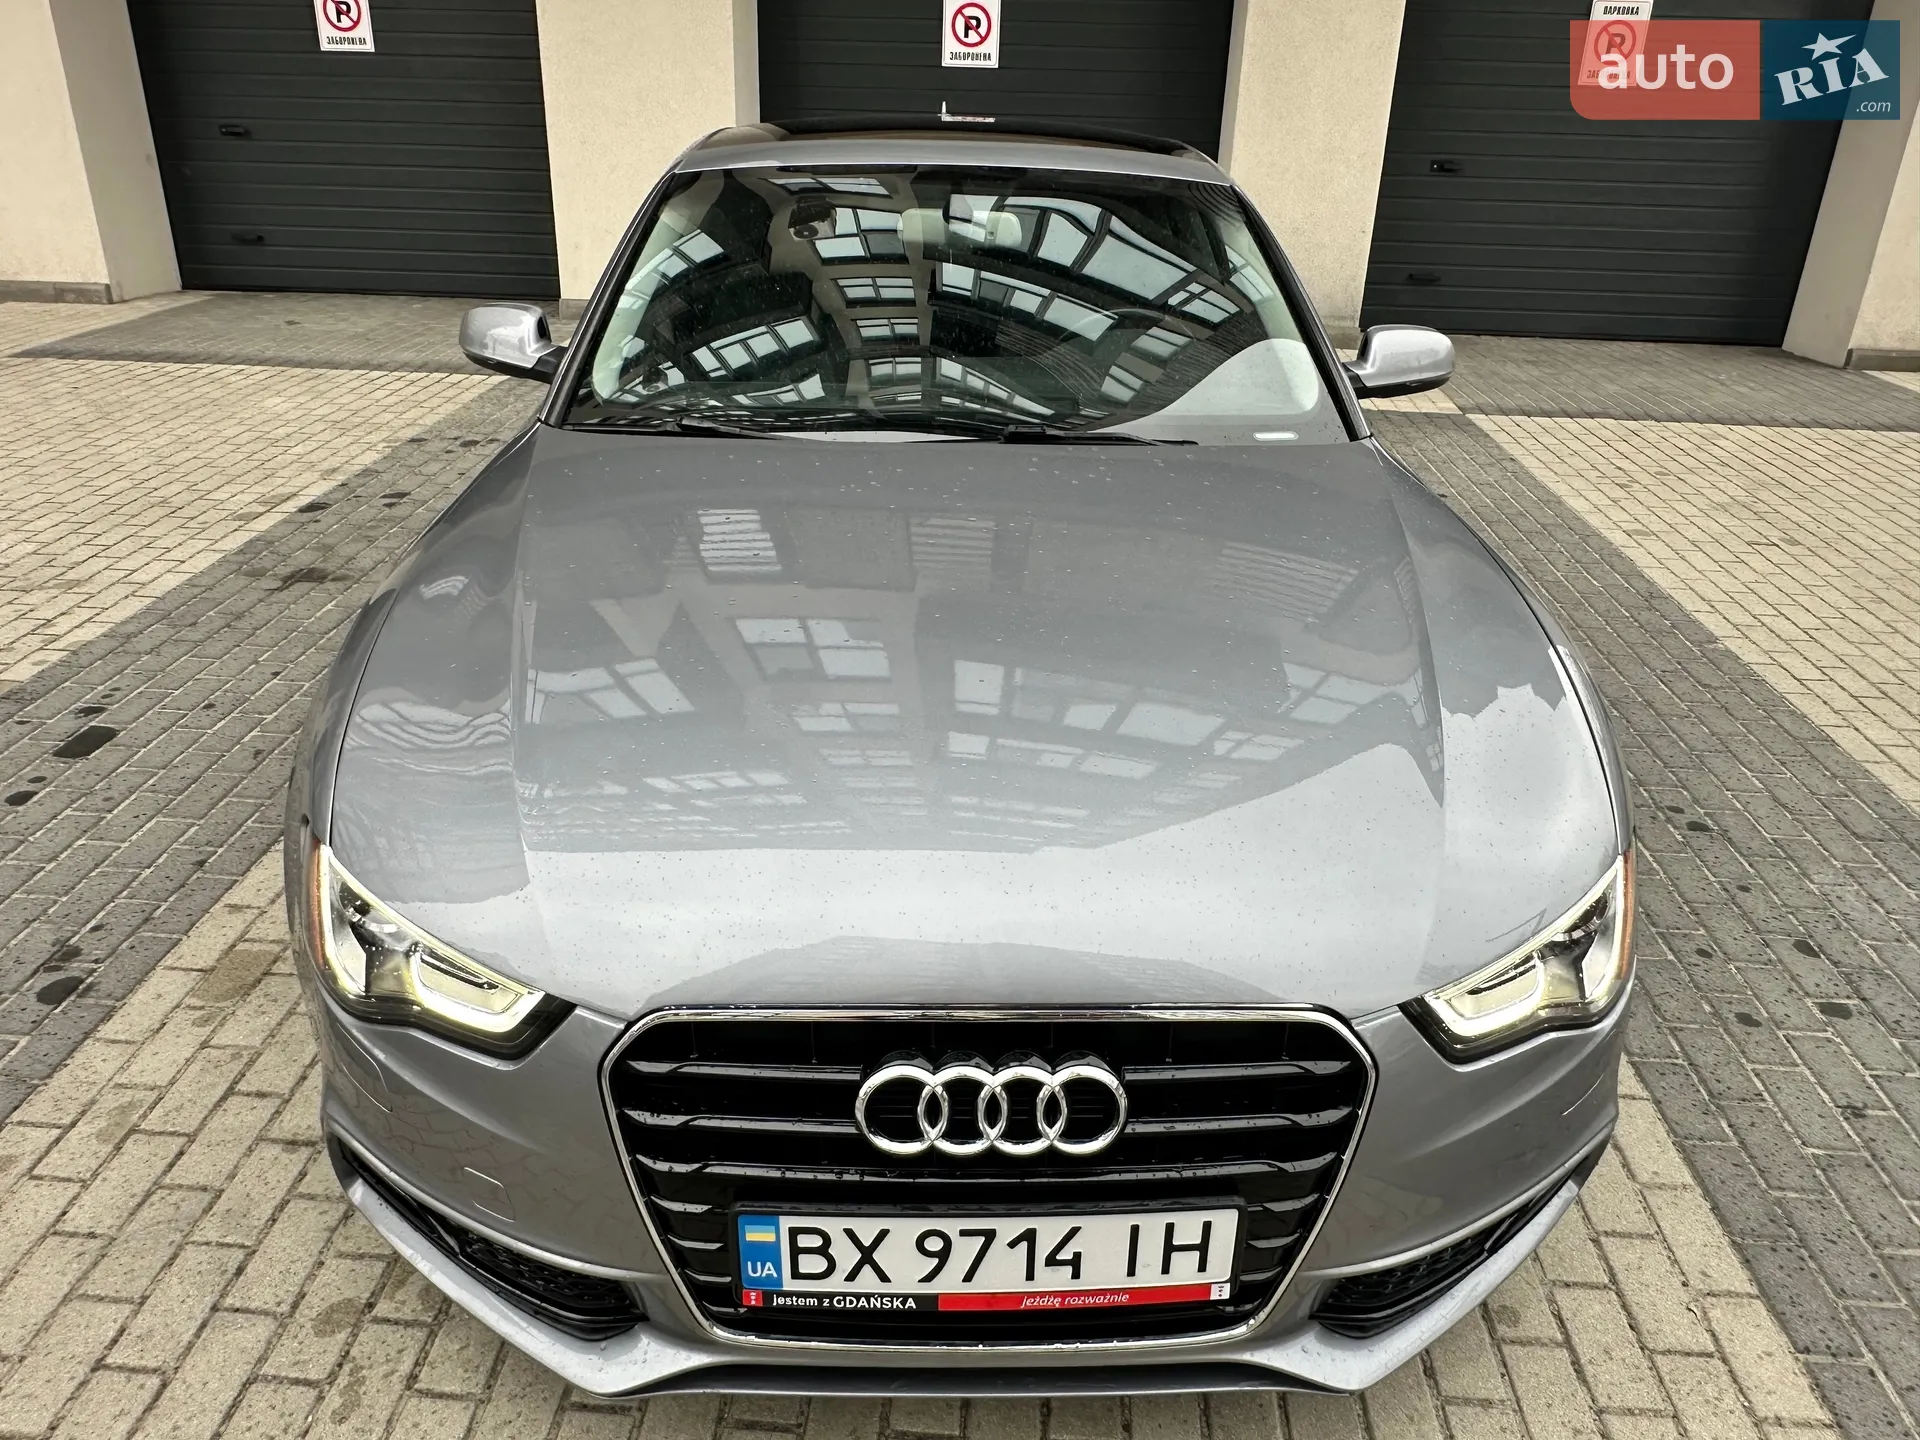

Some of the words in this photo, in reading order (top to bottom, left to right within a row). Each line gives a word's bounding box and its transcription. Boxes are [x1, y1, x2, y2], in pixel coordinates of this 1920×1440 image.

[1603, 5, 1640, 16] ПАРКОВКА
[788, 1226, 892, 1283] BX
[915, 1225, 1082, 1283] 9714
[1126, 1220, 1213, 1277] IH
[747, 1261, 778, 1278] UA
[772, 1294, 818, 1306] jestem
[823, 1299, 830, 1307] z
[833, 1294, 917, 1309] GDAŃSKA
